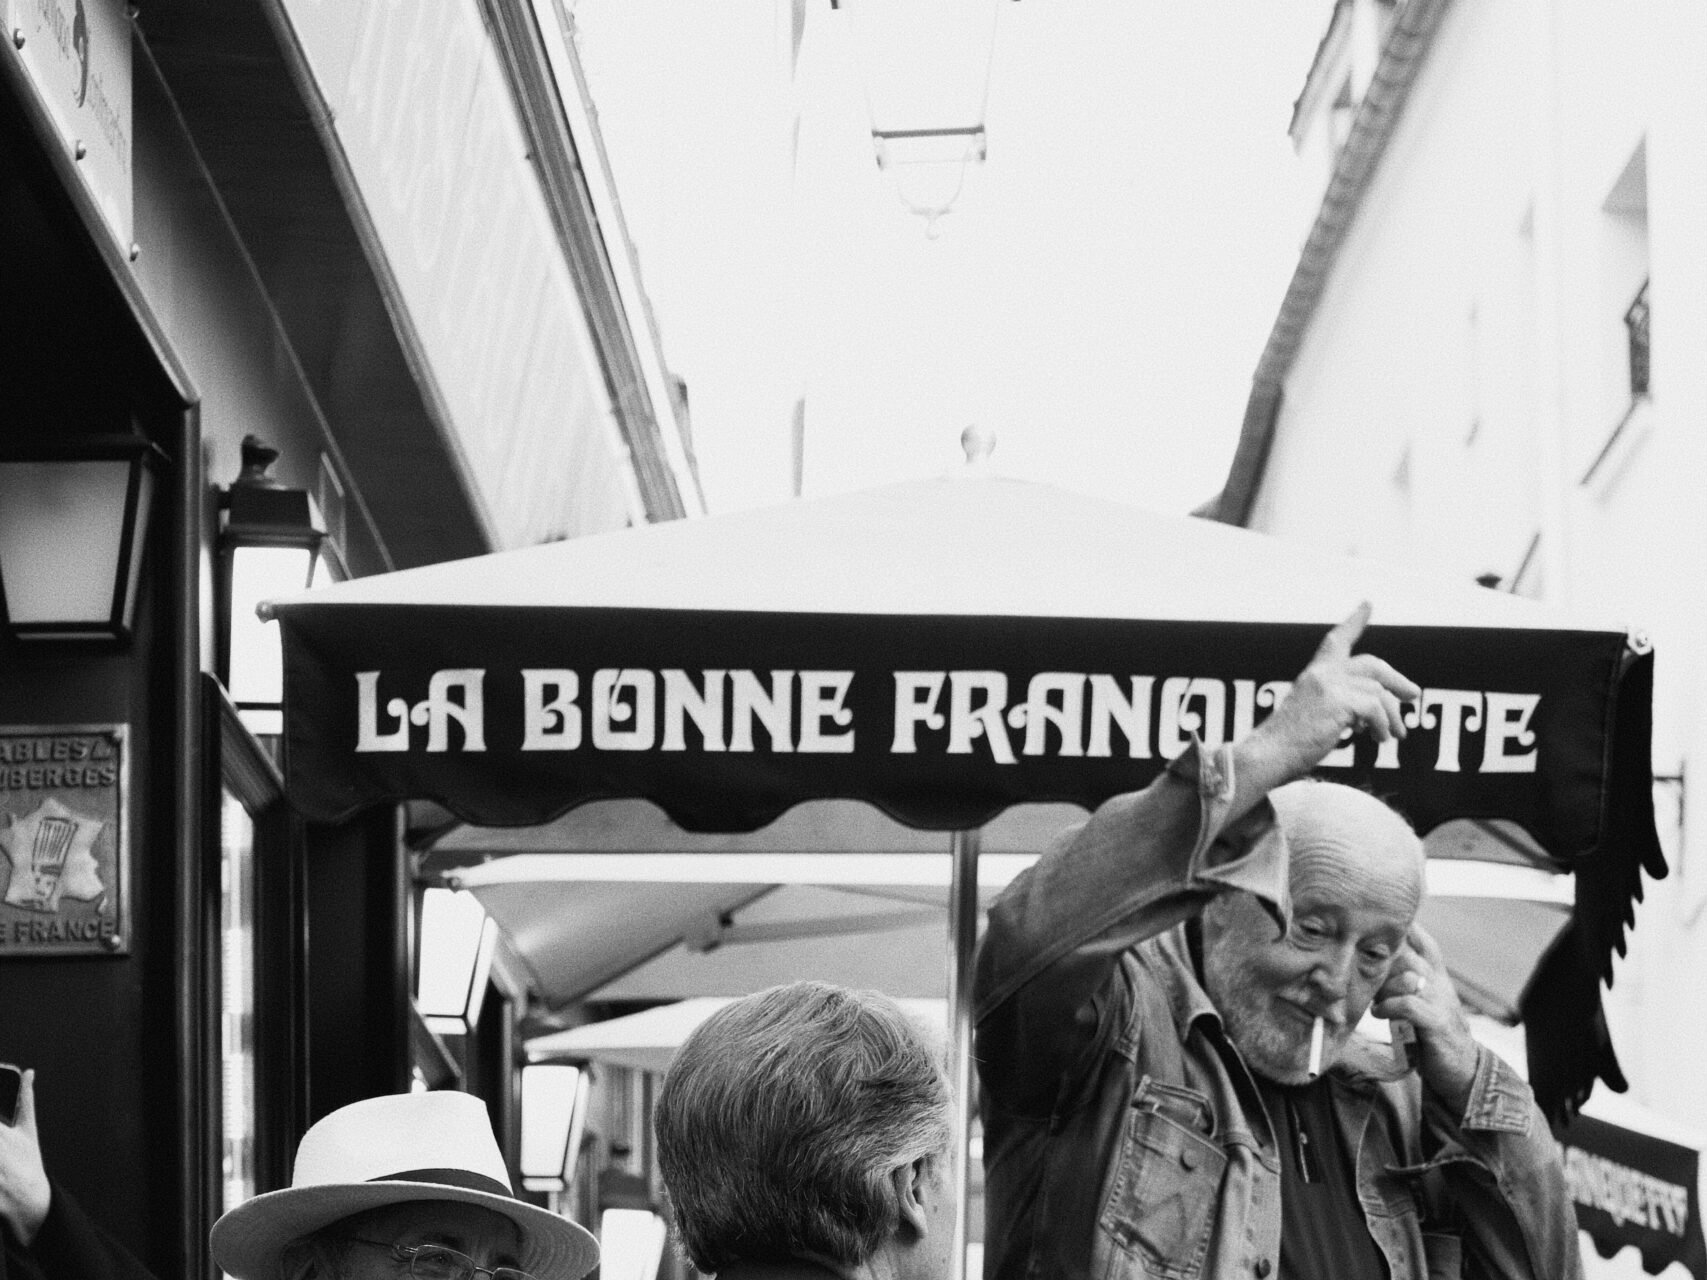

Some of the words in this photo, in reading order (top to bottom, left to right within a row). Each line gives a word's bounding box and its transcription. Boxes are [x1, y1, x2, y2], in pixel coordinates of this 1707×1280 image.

[355, 668, 487, 753] LA
[520, 668, 855, 754] BONNE
[890, 670, 1542, 773] FRANQUTE
[13, 919, 116, 944] FRANCE
